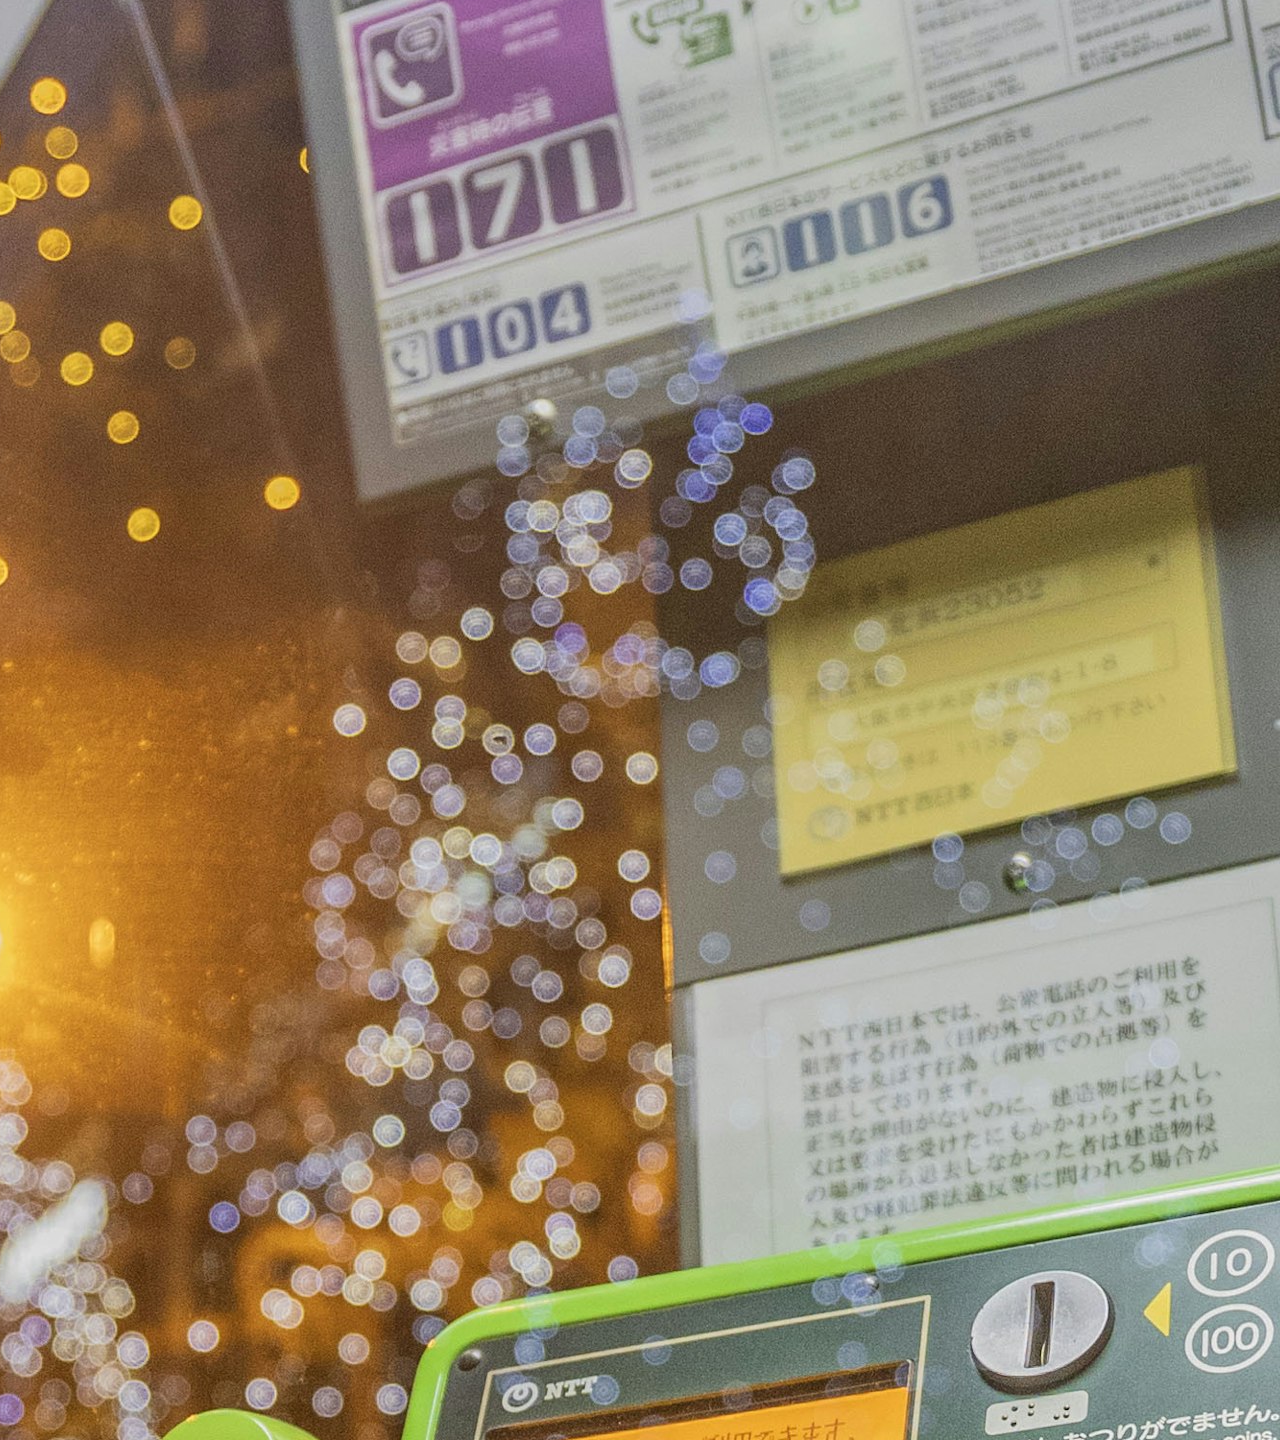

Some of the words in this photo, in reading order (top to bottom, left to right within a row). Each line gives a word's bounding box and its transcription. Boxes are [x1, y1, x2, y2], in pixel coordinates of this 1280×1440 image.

[411, 140, 599, 262] 171
[799, 180, 940, 268] 116
[447, 287, 581, 367] 104
[1209, 1247, 1253, 1282] 10
[1201, 1320, 1261, 1358] 100
[544, 1375, 598, 1401] NTT
